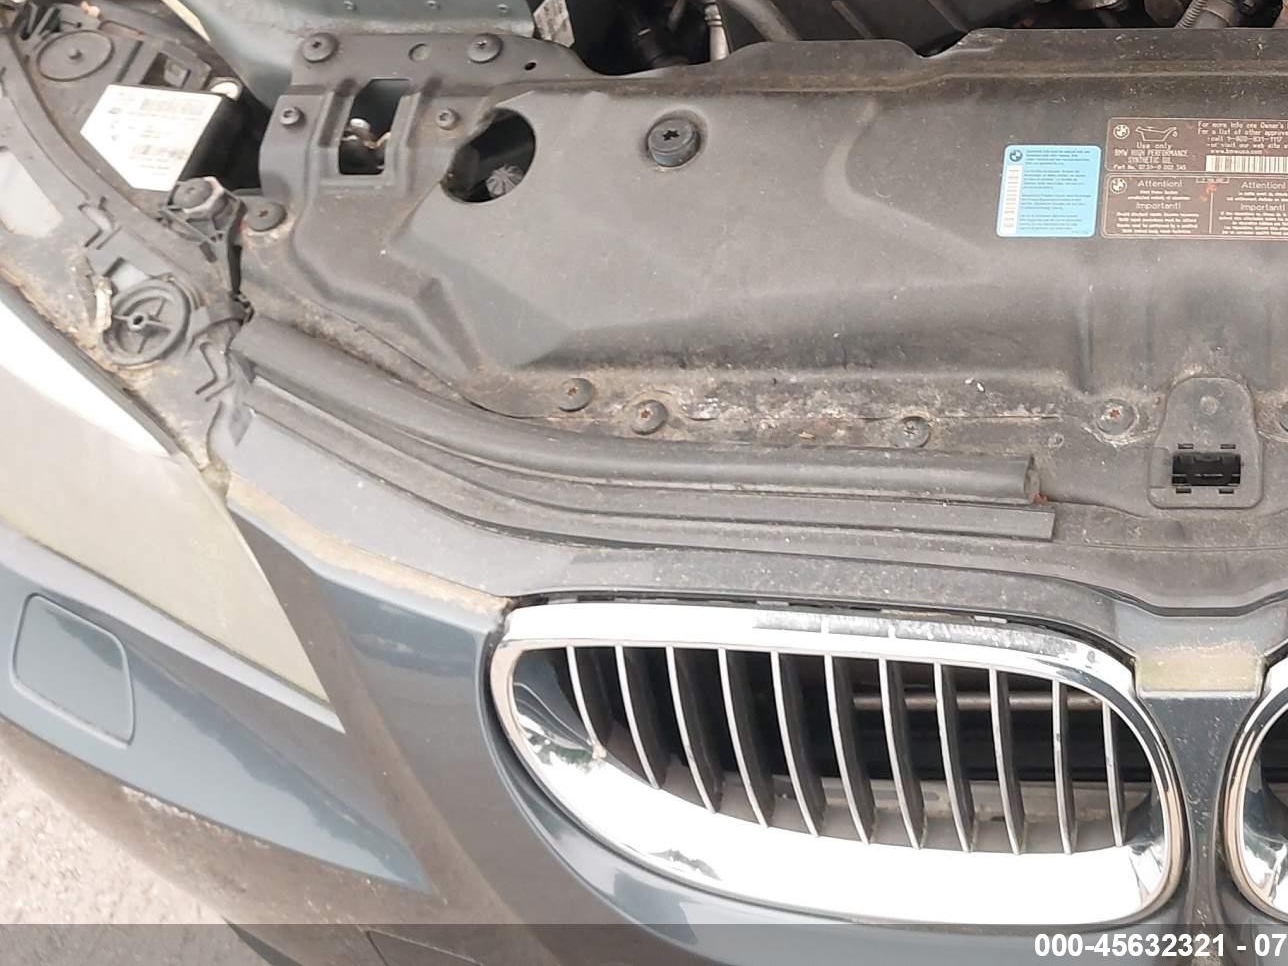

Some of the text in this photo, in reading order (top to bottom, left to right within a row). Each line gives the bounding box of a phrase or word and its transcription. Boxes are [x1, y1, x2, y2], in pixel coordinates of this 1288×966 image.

[1136, 141, 1172, 150] Use only
[1114, 148, 1129, 156] BMW
[1147, 149, 1189, 157] PERFORMANCE
[1128, 156, 1160, 164] SYNTHETIC
[1137, 180, 1183, 188] Attention!
[1241, 181, 1286, 189] Attention!
[1136, 202, 1181, 210] Important!
[1240, 203, 1286, 211] Important!
